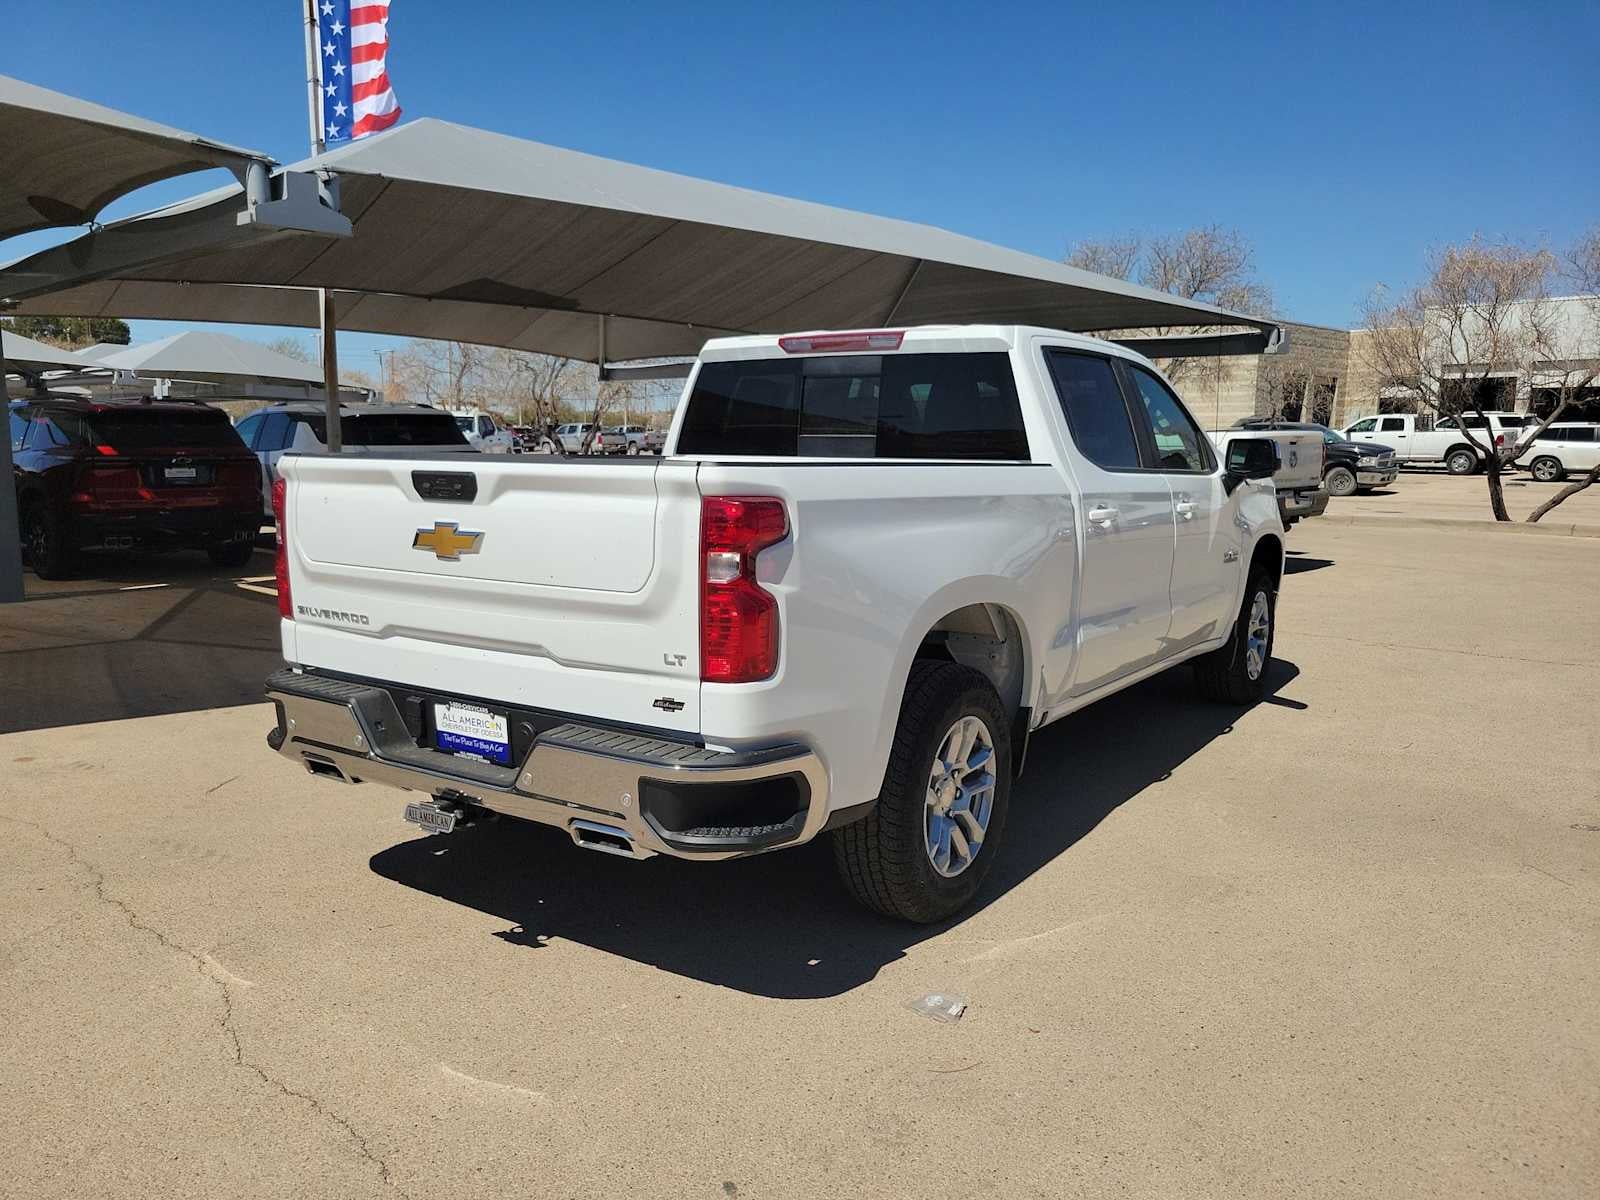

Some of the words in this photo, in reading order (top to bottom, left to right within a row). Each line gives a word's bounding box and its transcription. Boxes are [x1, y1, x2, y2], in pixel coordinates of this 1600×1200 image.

[297, 605, 369, 625] SILVERADO
[663, 653, 687, 667] LT
[442, 713, 457, 723] ALL
[460, 716, 502, 731] AMERICN
